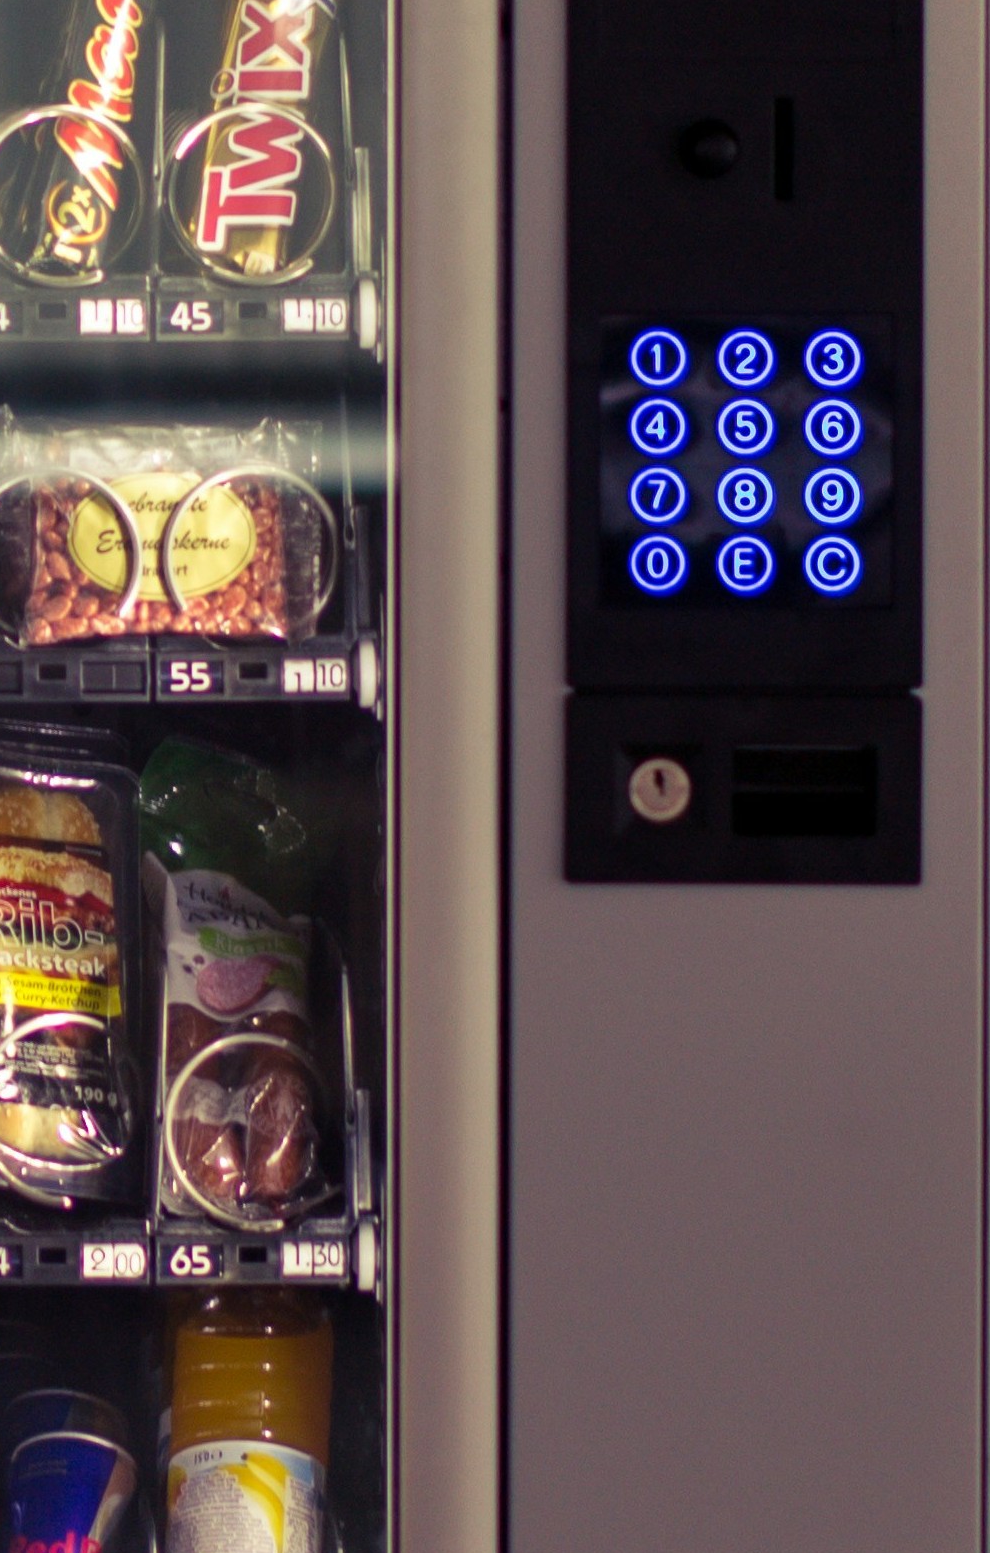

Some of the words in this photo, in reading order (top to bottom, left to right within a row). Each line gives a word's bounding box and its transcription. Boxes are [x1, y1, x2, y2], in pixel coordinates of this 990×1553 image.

[170, 302, 211, 330] 45
[650, 343, 662, 374] 1
[734, 343, 757, 375] 2
[822, 343, 845, 375] 3
[645, 411, 666, 441] 4
[734, 411, 757, 442] 5
[821, 411, 844, 442] 6
[647, 479, 667, 509] 7
[734, 479, 756, 511] 8
[821, 479, 844, 511] 9
[646, 547, 670, 579] 0
[733, 547, 755, 580] E
[817, 547, 847, 580] C
[170, 662, 210, 692] 55
[74, 1085, 104, 1102] 190
[170, 1246, 211, 1275] 65
